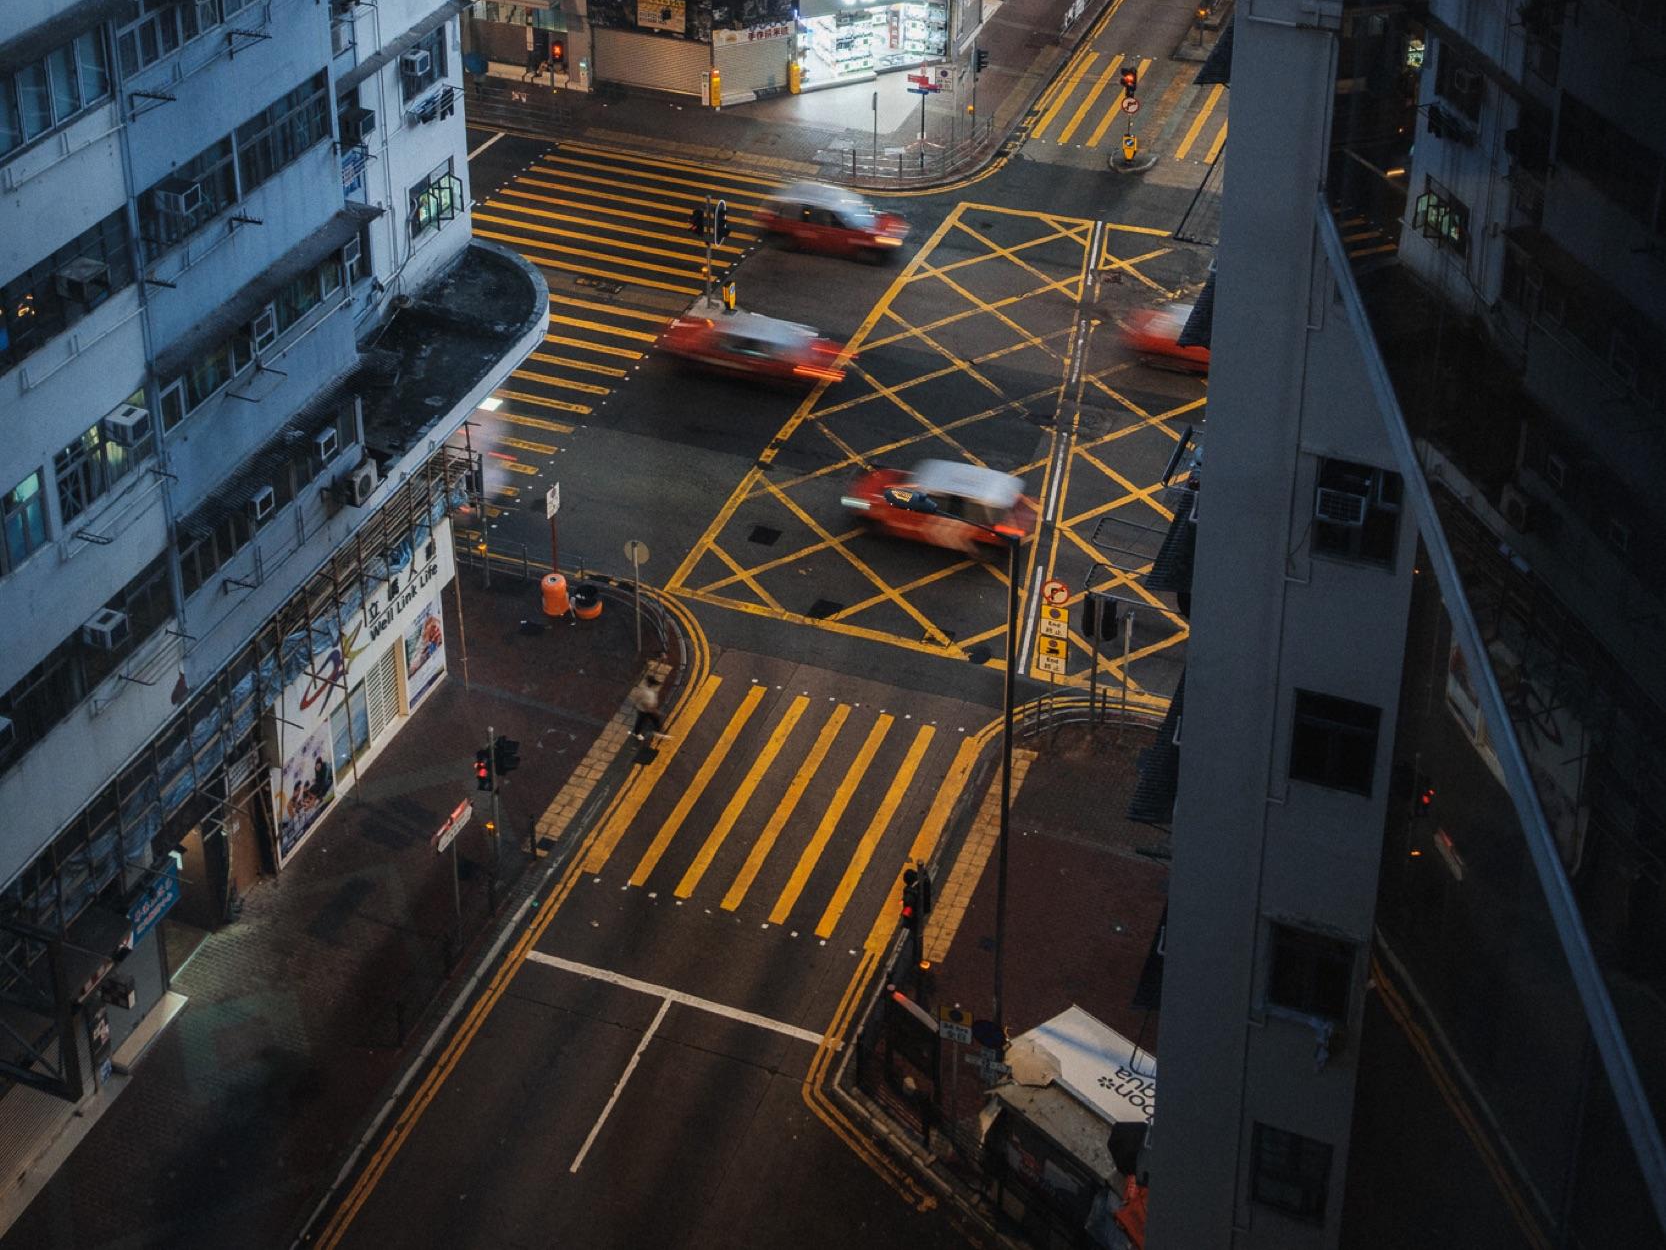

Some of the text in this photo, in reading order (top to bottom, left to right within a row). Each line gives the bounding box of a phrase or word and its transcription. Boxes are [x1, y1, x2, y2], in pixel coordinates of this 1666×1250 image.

[370, 608, 394, 641] Well
[397, 584, 418, 614] Link
[420, 564, 438, 588] Life
